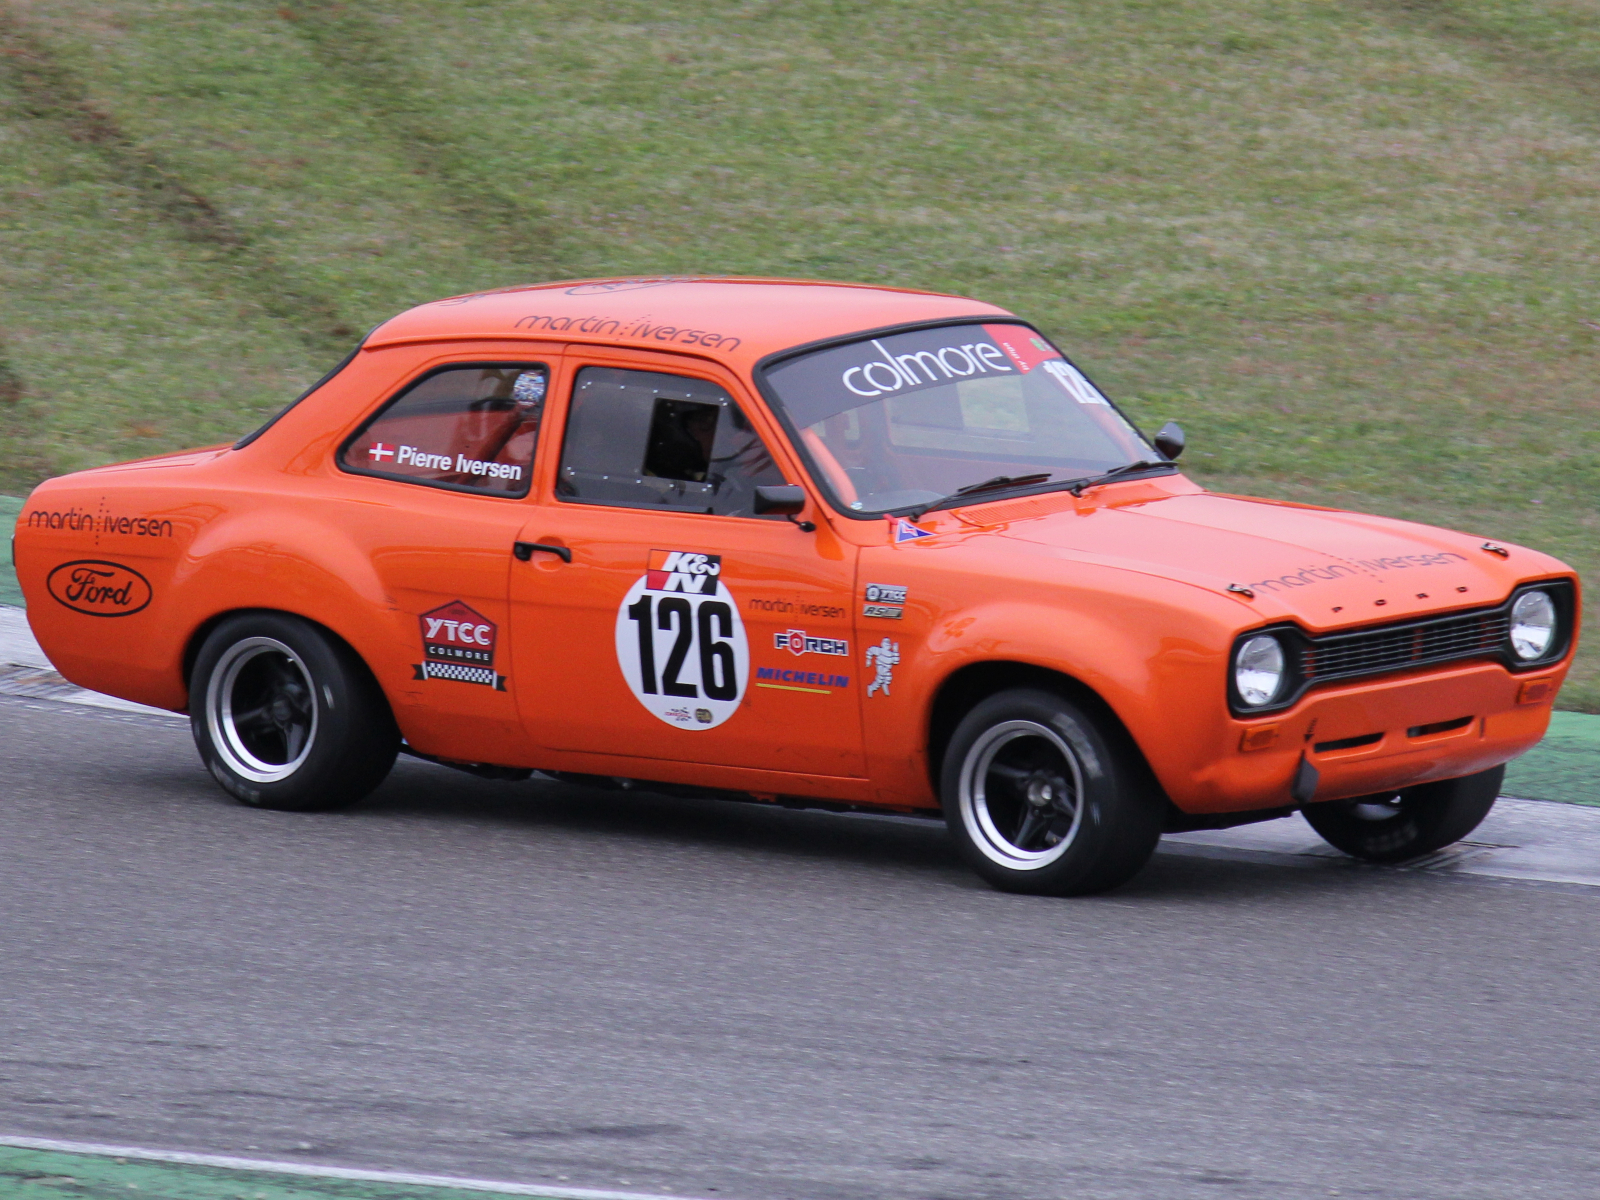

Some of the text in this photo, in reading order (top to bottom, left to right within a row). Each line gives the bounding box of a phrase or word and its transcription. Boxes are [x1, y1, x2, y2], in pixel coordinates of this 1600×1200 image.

[513, 315, 742, 352] martin iversen
[842, 339, 1012, 397] colmore
[396, 445, 522, 481] Pierre Iversen
[28, 507, 173, 538] martin iversen
[66, 568, 133, 606] Ford
[1250, 551, 1468, 594] martin iversen
[749, 598, 846, 619] martin iversen
[425, 617, 491, 646] YTCC
[628, 594, 738, 702] 126
[429, 646, 490, 661] COLMORE
[756, 667, 849, 687] MICHELIN
